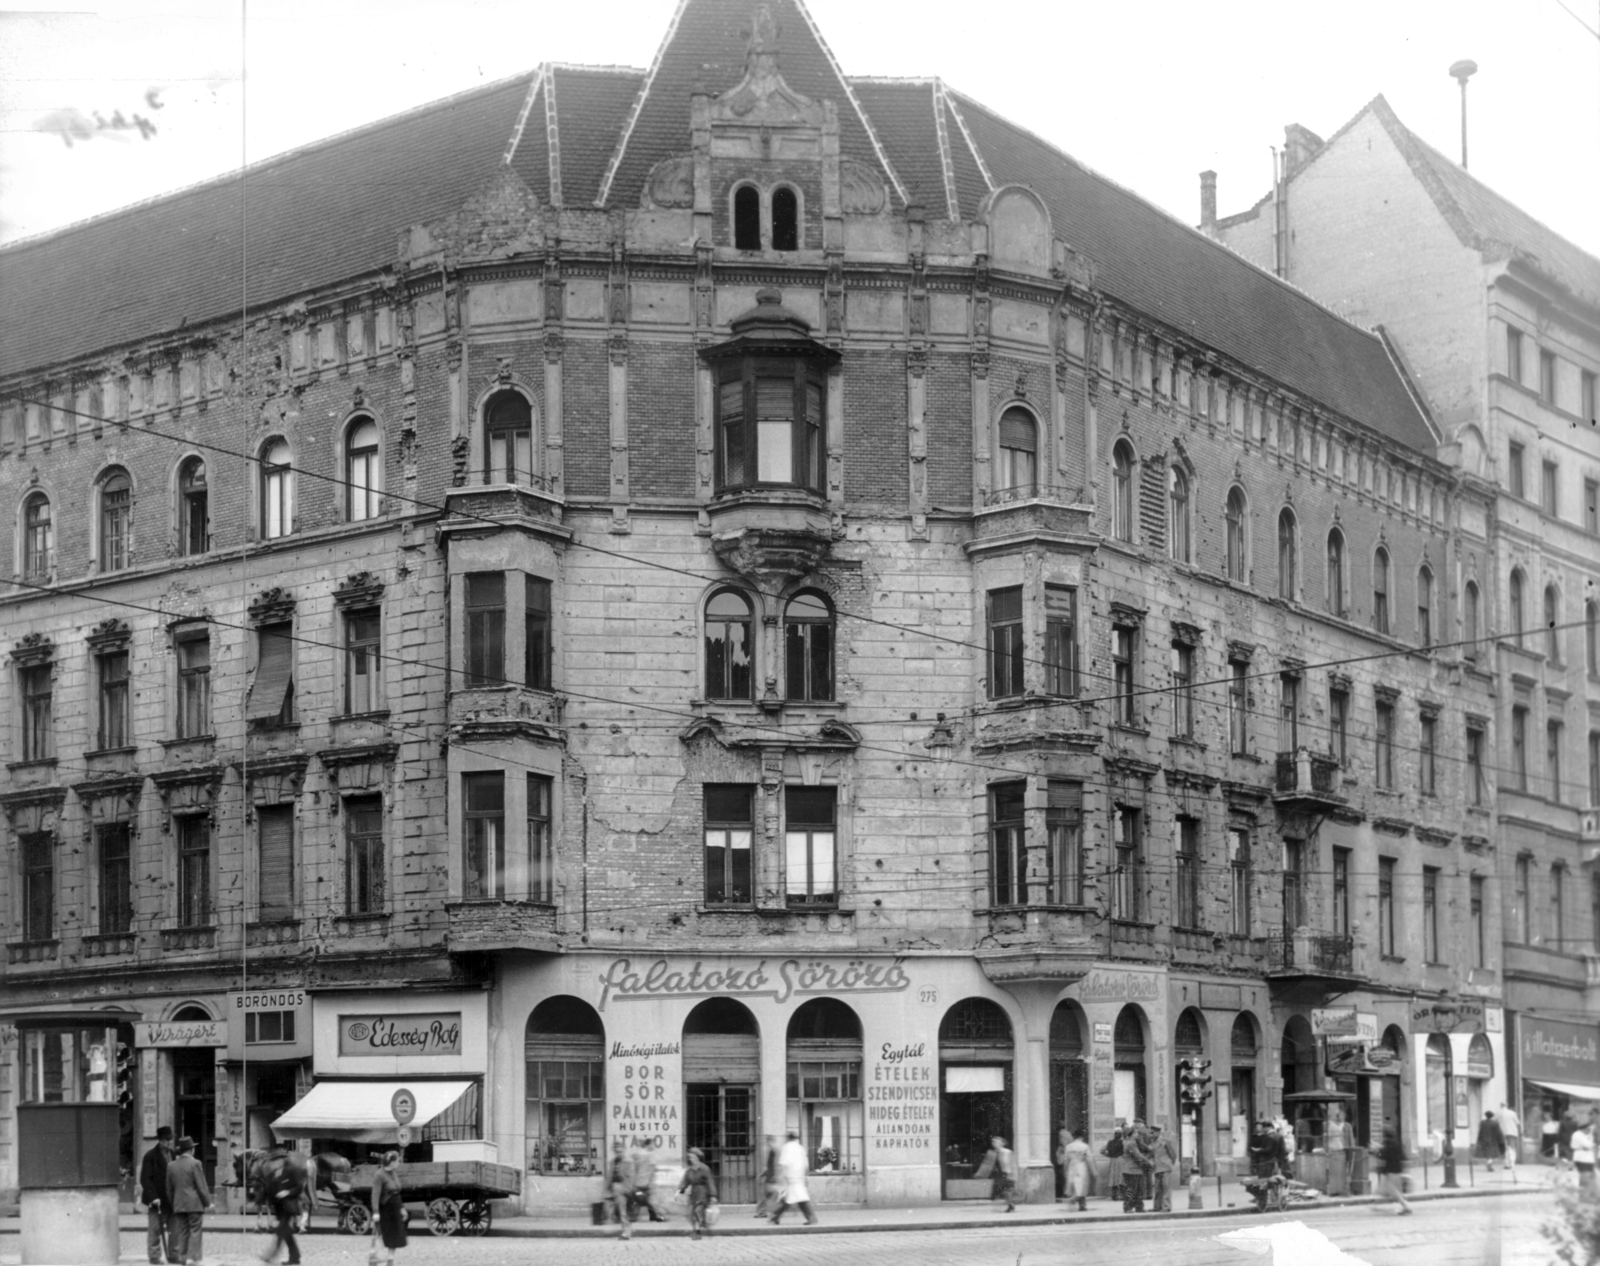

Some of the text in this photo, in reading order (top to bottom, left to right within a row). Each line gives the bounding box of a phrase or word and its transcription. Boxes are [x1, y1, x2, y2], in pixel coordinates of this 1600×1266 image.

[919, 990, 938, 1003] 275
[881, 1042, 925, 1064] Egytál
[624, 1065, 664, 1080] BOR
[874, 1062, 930, 1081] ÉTELEK
[624, 1081, 665, 1100] SÖR
[868, 1086, 937, 1101] SZENDVICSEK
[613, 1101, 678, 1119] PÁLINKA
[869, 1102, 935, 1120] HIDEG ÉTELEK
[876, 1121, 931, 1134] ÁLLANDÓAN
[612, 1134, 677, 1149] ITAOK
[876, 1135, 930, 1149] KAPHATÓK
